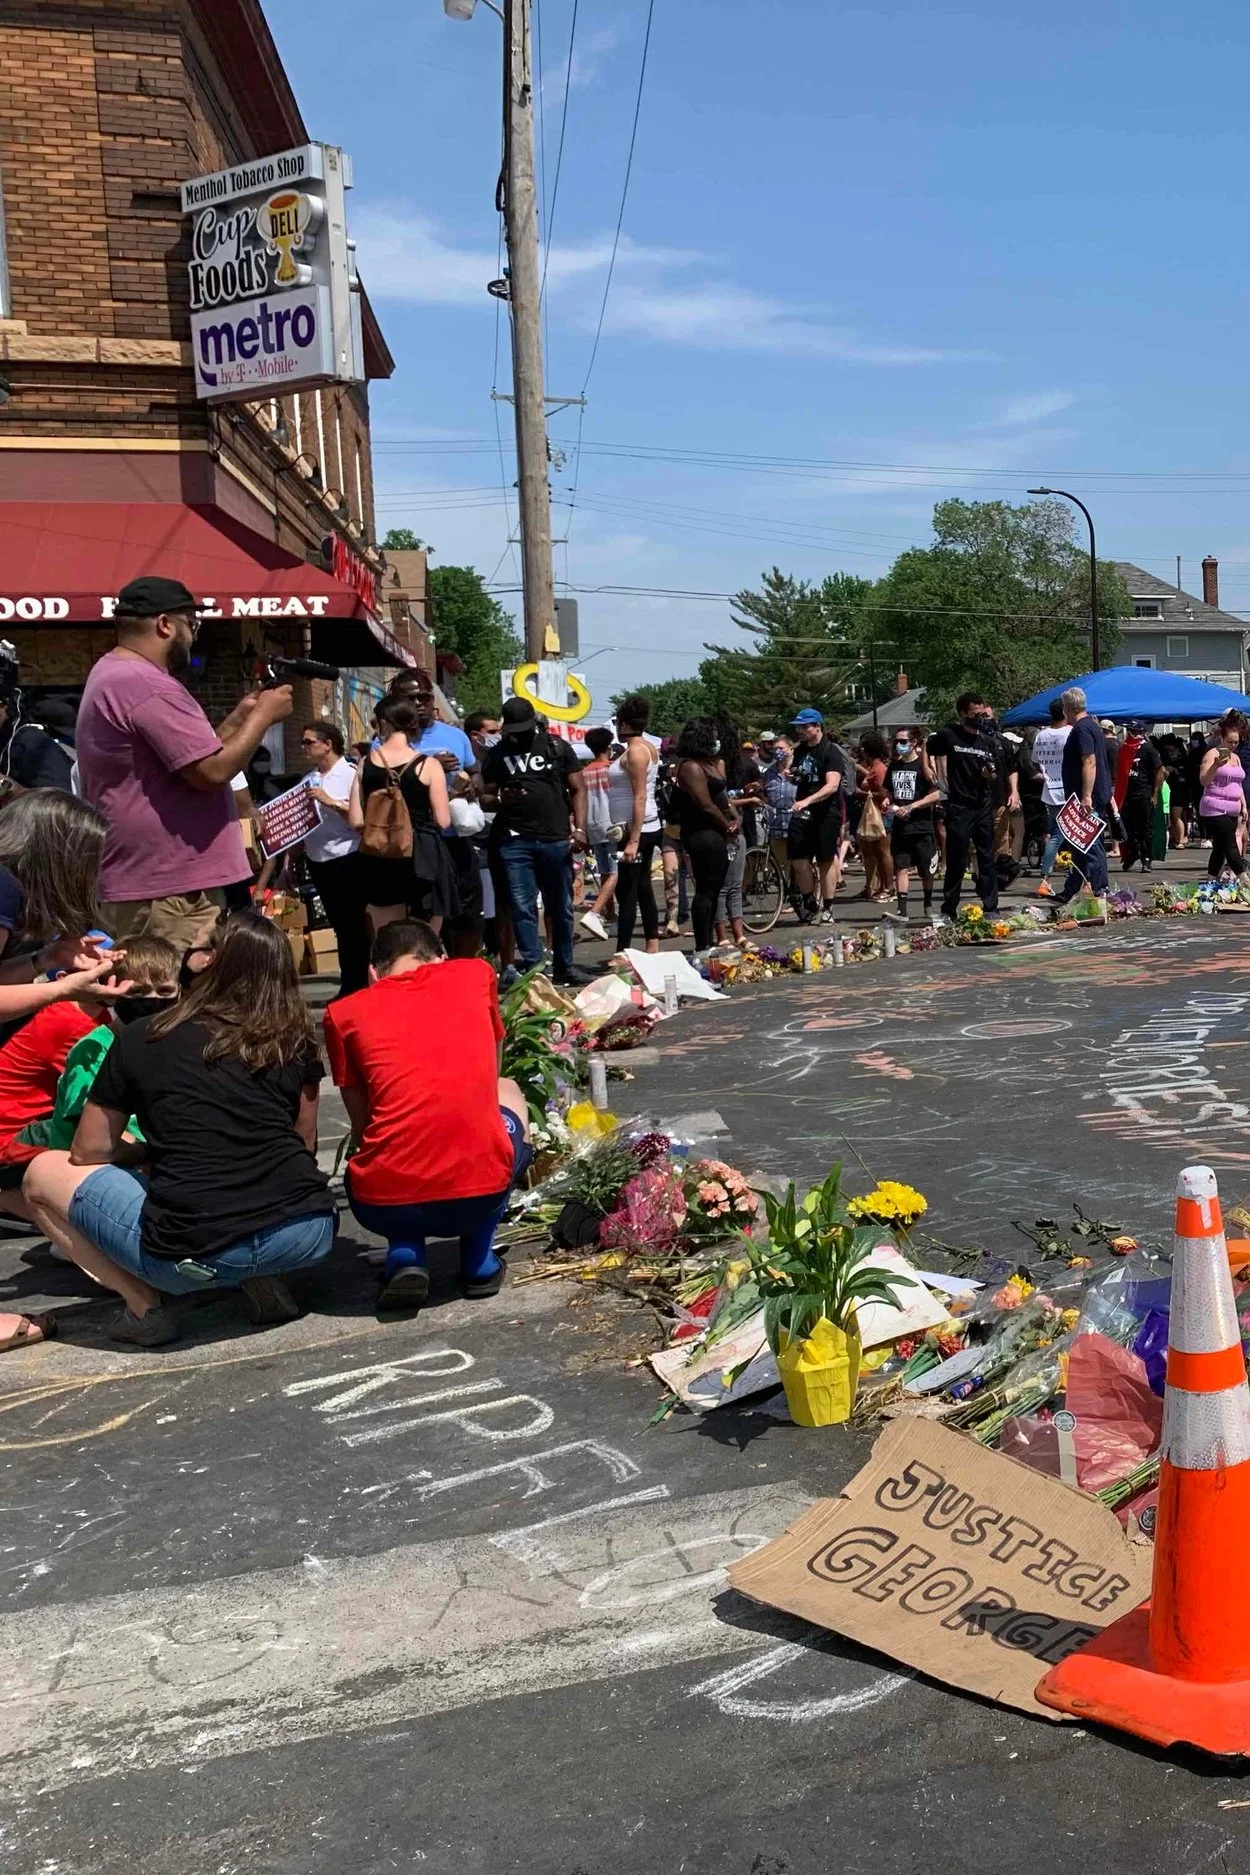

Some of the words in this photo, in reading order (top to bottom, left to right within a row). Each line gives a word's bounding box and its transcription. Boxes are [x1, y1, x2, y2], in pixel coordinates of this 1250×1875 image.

[185, 175, 227, 206] Menthol
[229, 168, 274, 192] Tobacco
[277, 155, 305, 180] Shop
[195, 208, 256, 261] Cup
[270, 208, 299, 240] DELI
[190, 251, 267, 306] Foods
[200, 302, 316, 387] metro
[220, 367, 235, 387] by
[231, 596, 330, 617] MEAT
[503, 752, 553, 776] We.
[874, 1458, 1132, 1613] JUSTICE
